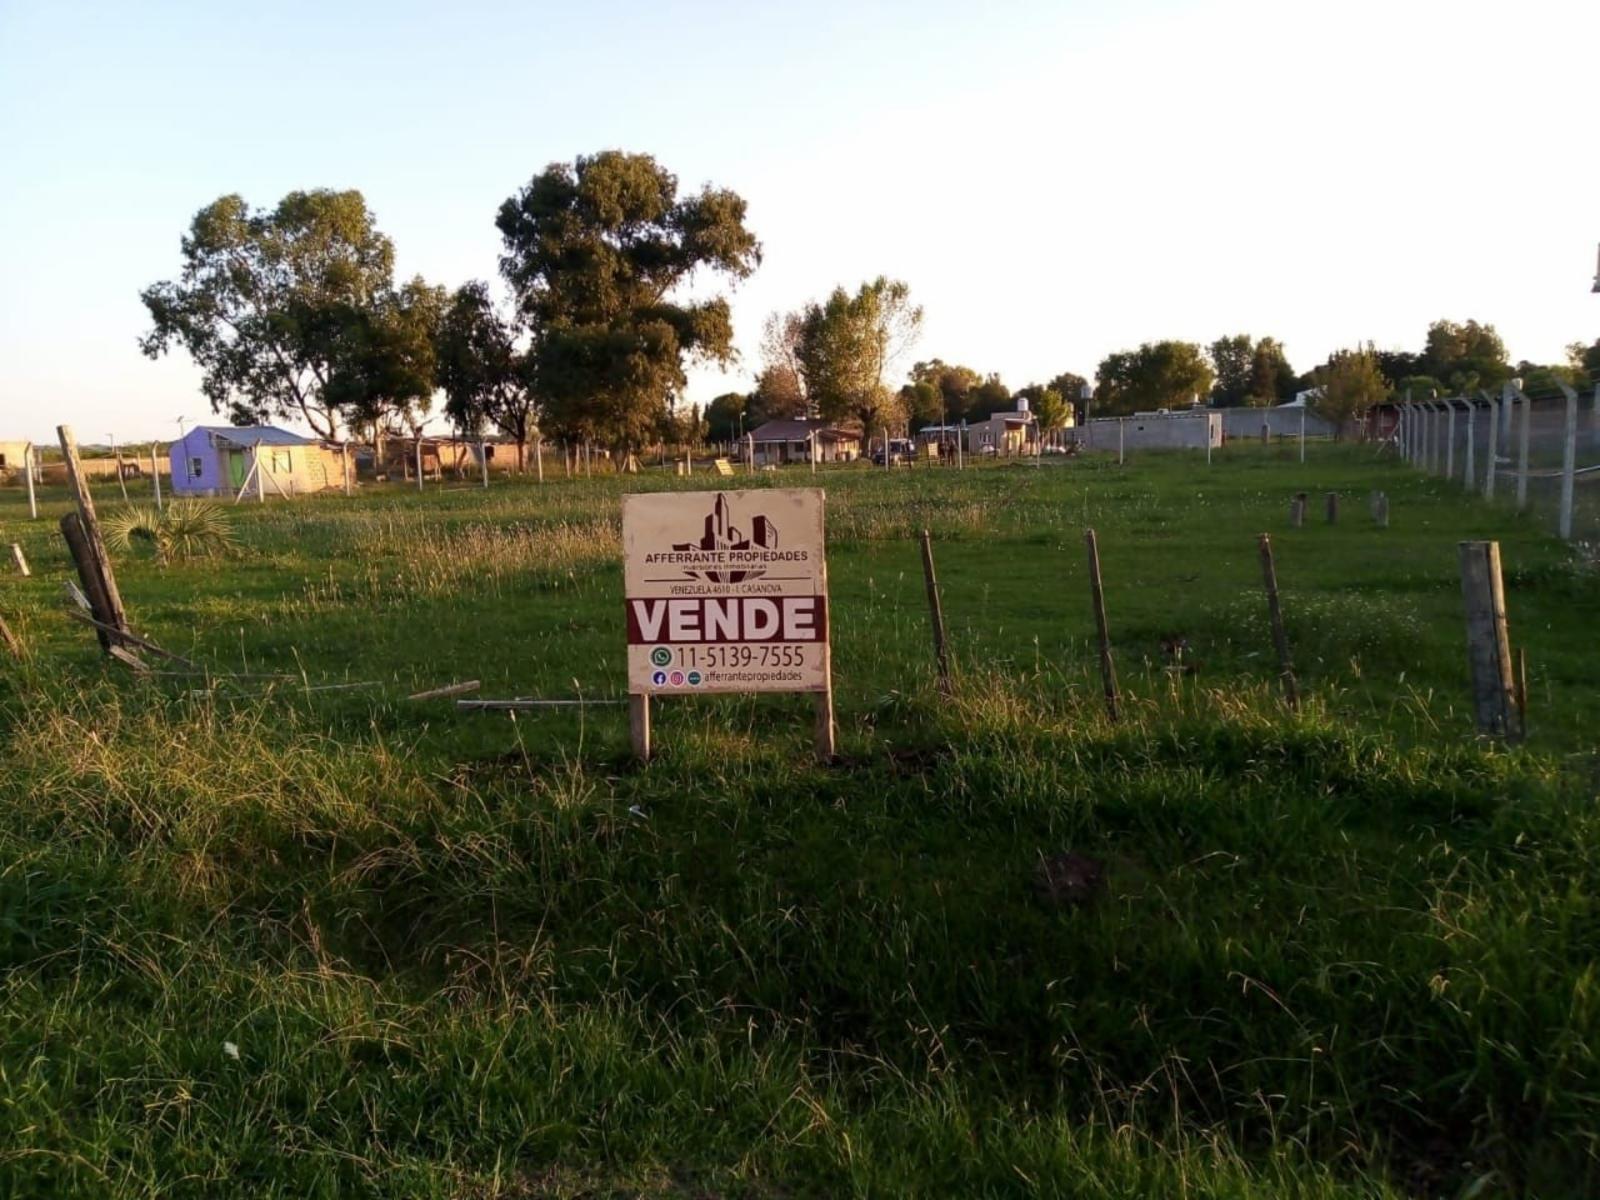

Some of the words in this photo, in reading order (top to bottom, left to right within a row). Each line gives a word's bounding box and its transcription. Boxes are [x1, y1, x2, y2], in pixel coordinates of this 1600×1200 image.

[645, 552, 726, 563] AFFERRANTE
[729, 551, 808, 562] PROPIEDADES
[670, 585, 711, 595] VENEZUELA
[742, 584, 782, 593] CASANOVA
[632, 598, 816, 640] VENDE
[678, 646, 804, 668] 11-5139-7555
[704, 671, 802, 683] afferrantepropiedades
